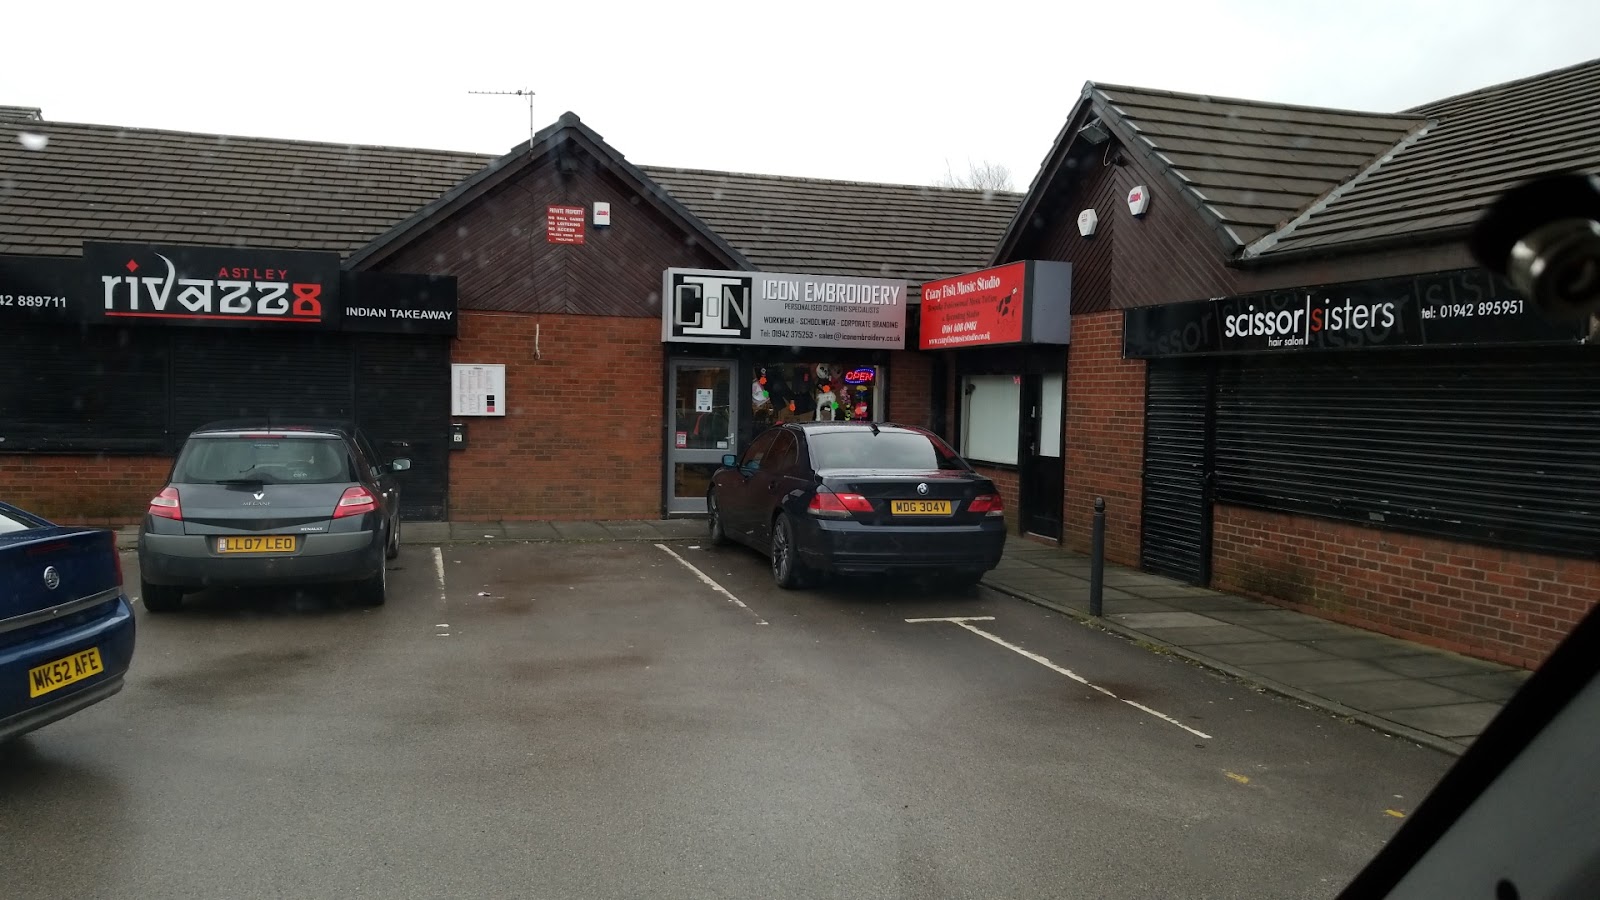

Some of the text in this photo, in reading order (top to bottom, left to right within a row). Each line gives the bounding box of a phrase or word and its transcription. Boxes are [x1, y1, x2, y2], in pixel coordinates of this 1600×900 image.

[218, 267, 288, 279] ASTLEY
[762, 279, 900, 306] ICON EMBROIDERY
[925, 276, 1000, 302] Crazy Fish Music Studio
[17, 295, 66, 308] 889711
[345, 307, 453, 320] INDIAN TAKEAWAY
[784, 303, 880, 314] PERSONALISED CLOTHING SPECIALISTS
[1421, 300, 1524, 319] tel: 01942 895951
[763, 316, 795, 325] WORKWEAR
[799, 317, 836, 327] SCHOOLWEAR
[840, 319, 872, 328] CORPORATE
[872, 320, 899, 329] BRANDING
[1225, 305, 1304, 338] scissor
[1311, 298, 1395, 332] sisters
[760, 329, 771, 338] Tel:
[771, 329, 790, 338] 01942
[790, 330, 814, 339] 375253
[1268, 335, 1304, 347] hair salon
[845, 371, 874, 382] OPEN
[896, 501, 946, 513] MDG 304V
[226, 537, 292, 551] LL07 LEO
[33, 652, 99, 691] MK52 AFE
